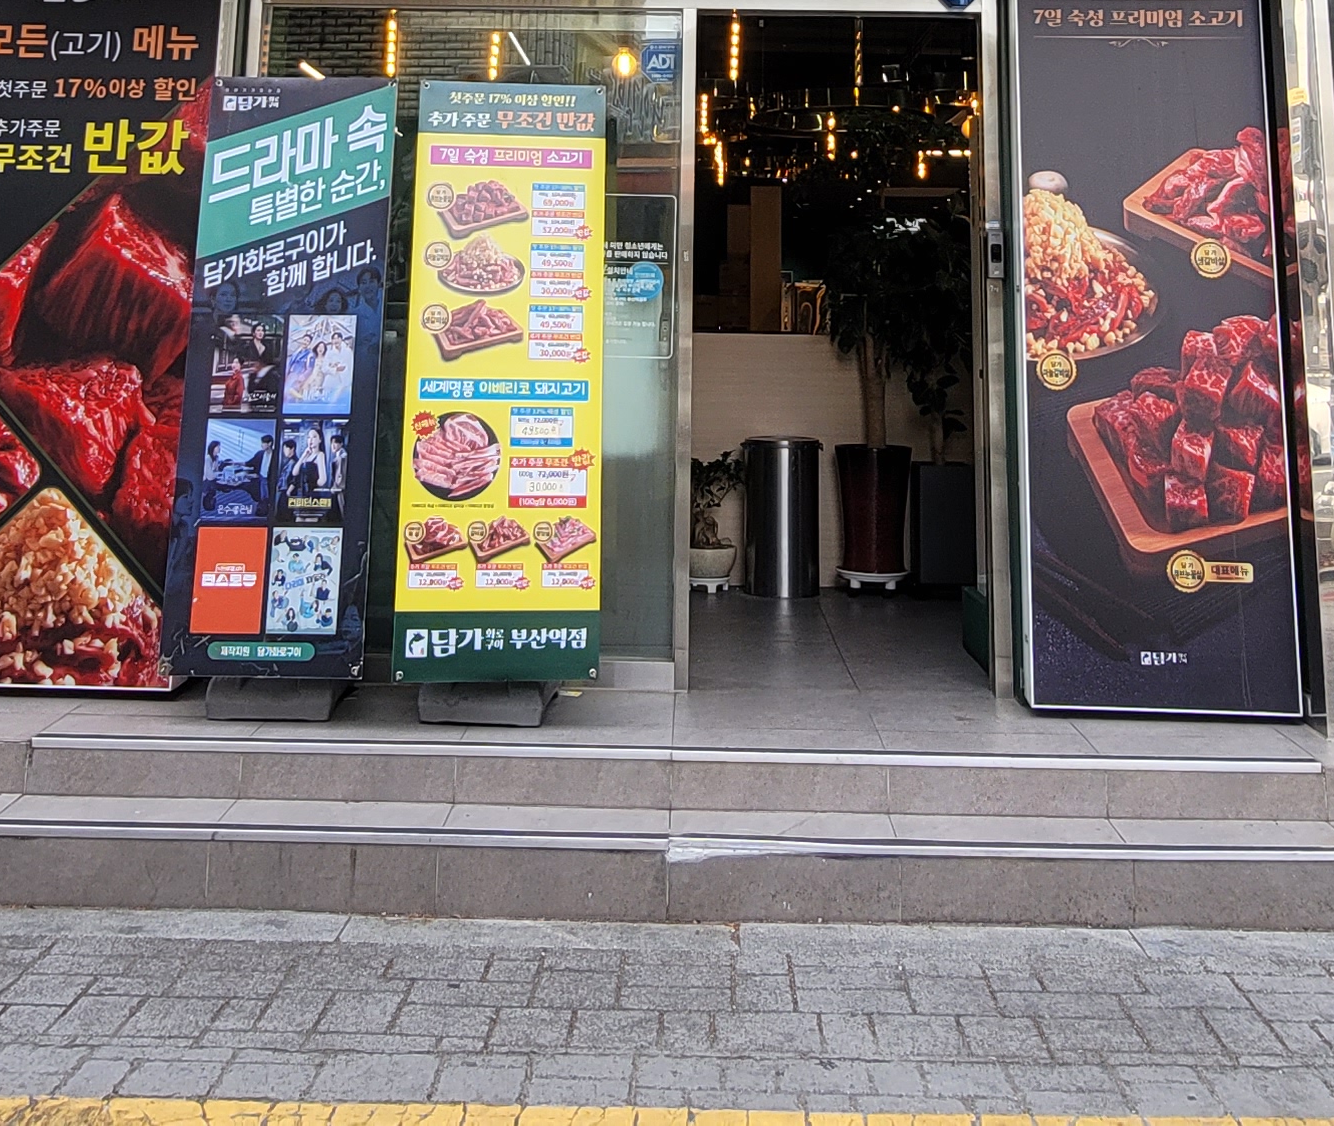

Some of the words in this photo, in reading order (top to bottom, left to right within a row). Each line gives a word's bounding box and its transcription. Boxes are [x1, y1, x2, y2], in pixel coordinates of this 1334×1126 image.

[1033, 9, 1063, 28] 7일
[1066, 9, 1105, 28] 숙성
[1110, 9, 1183, 29] 프리미엄
[1187, 9, 1244, 29] 소고기
[132, 25, 200, 61] 메뉴
[647, 53, 676, 70] ADT
[153, 77, 198, 102] 할인
[448, 90, 486, 105] 첫주문
[488, 93, 512, 104] 17%
[514, 93, 539, 106] 이상
[427, 110, 459, 128] 추가
[460, 111, 492, 129] 주문
[495, 109, 553, 131] 무조건
[555, 111, 596, 133] 반값
[83, 118, 190, 176] 반값
[207, 116, 340, 204] 드라마
[346, 104, 388, 154] 속
[438, 147, 459, 163] 7일
[463, 147, 489, 165] 숙성
[493, 148, 543, 166] 프리미엄
[546, 149, 583, 165] 소고기
[249, 176, 326, 226] 특별한
[330, 158, 386, 205] 순간,
[203, 220, 348, 290] 담가화로구이가
[265, 260, 308, 297] 함께
[311, 238, 377, 283] 합니다.
[421, 380, 475, 398] 세계명품
[479, 381, 531, 395] 이베리코
[534, 382, 586, 396] 돼지고기
[430, 628, 484, 658] 담가
[509, 627, 588, 650] 부산역점
